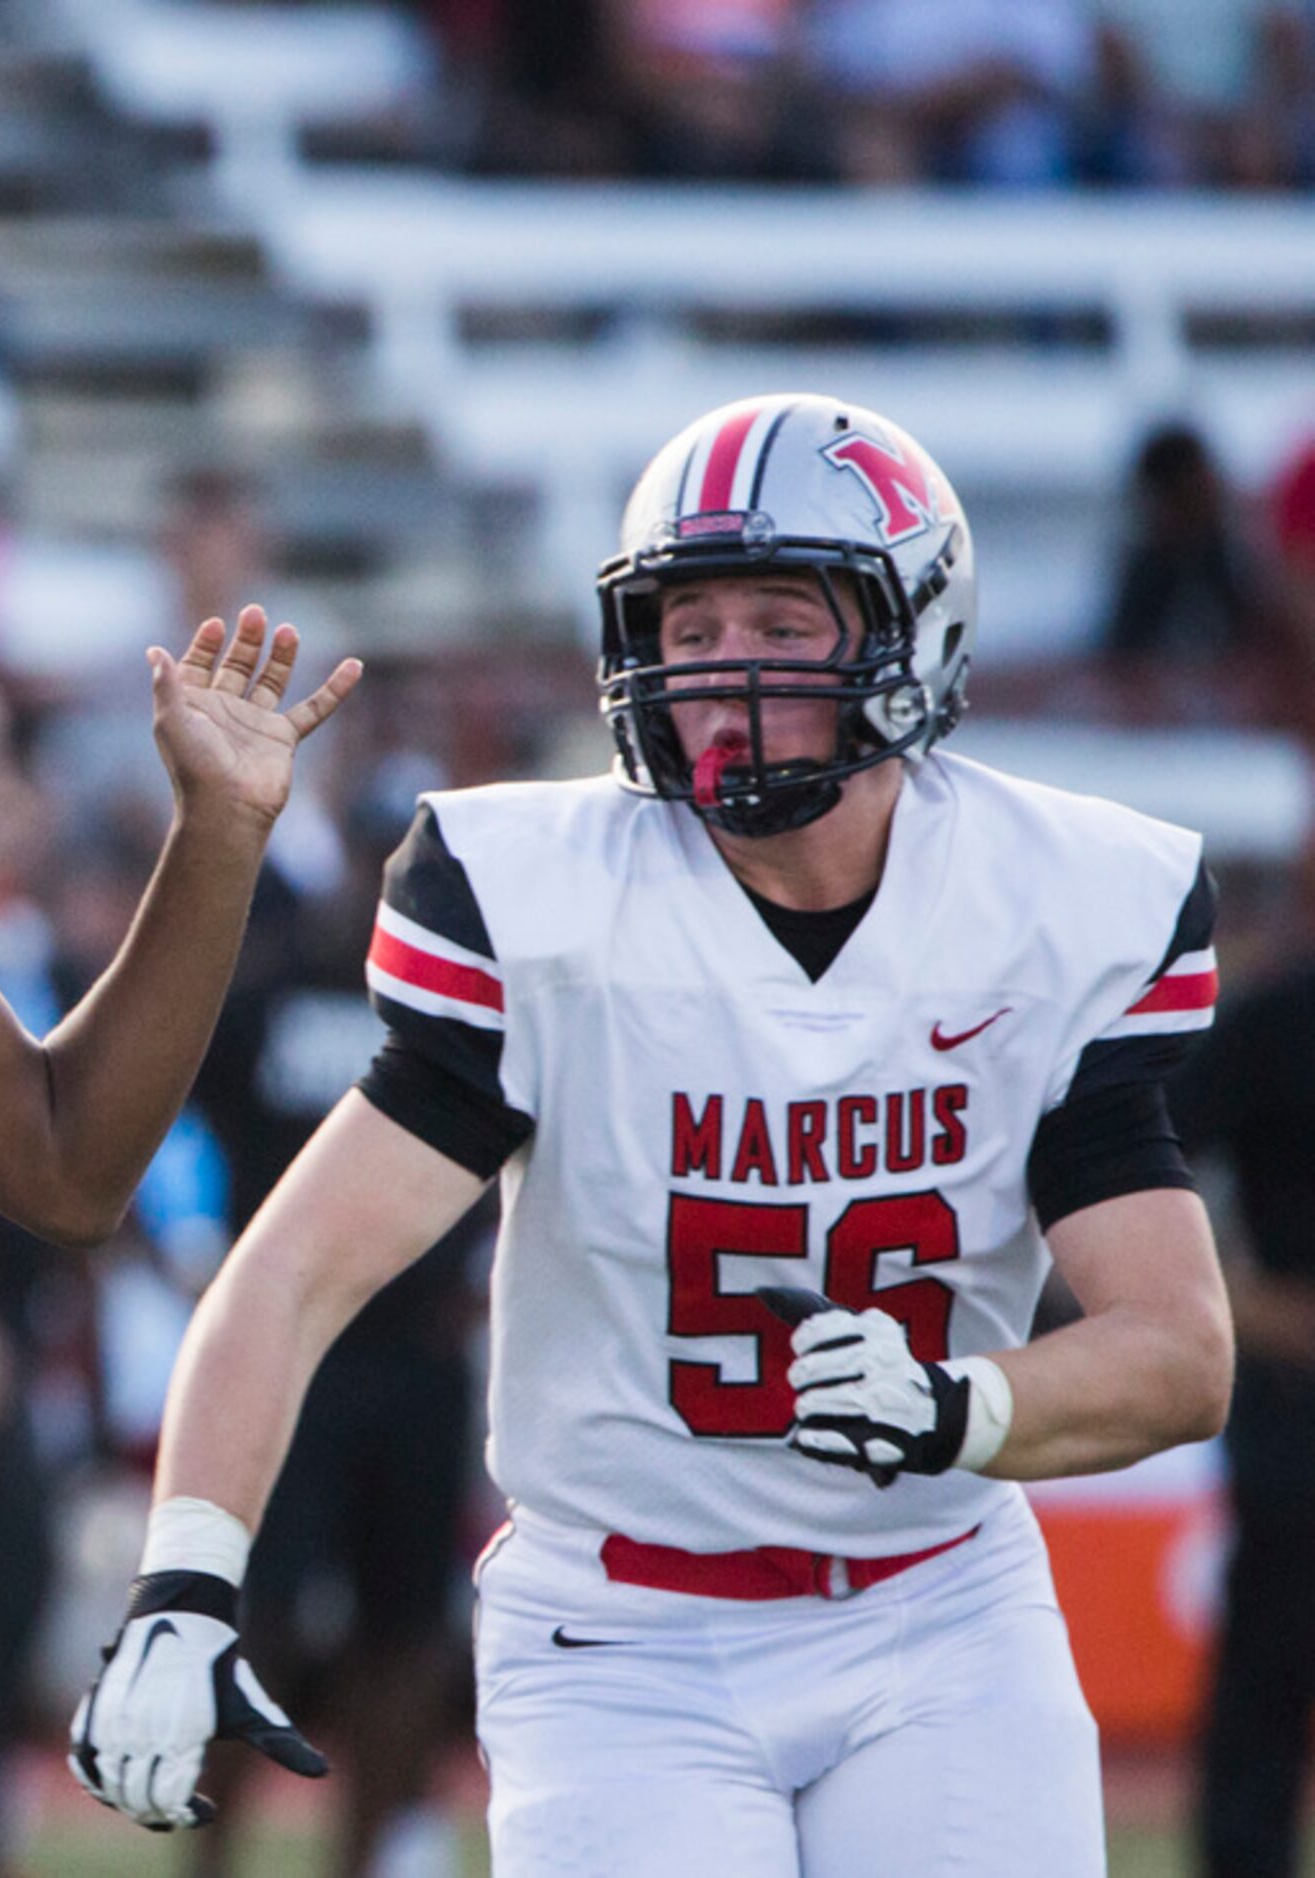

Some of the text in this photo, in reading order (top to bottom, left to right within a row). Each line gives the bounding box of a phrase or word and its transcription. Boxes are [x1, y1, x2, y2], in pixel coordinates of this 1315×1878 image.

[818, 432, 959, 548] M
[669, 1084, 970, 1187] MARCUS
[665, 1188, 961, 1440] 56
